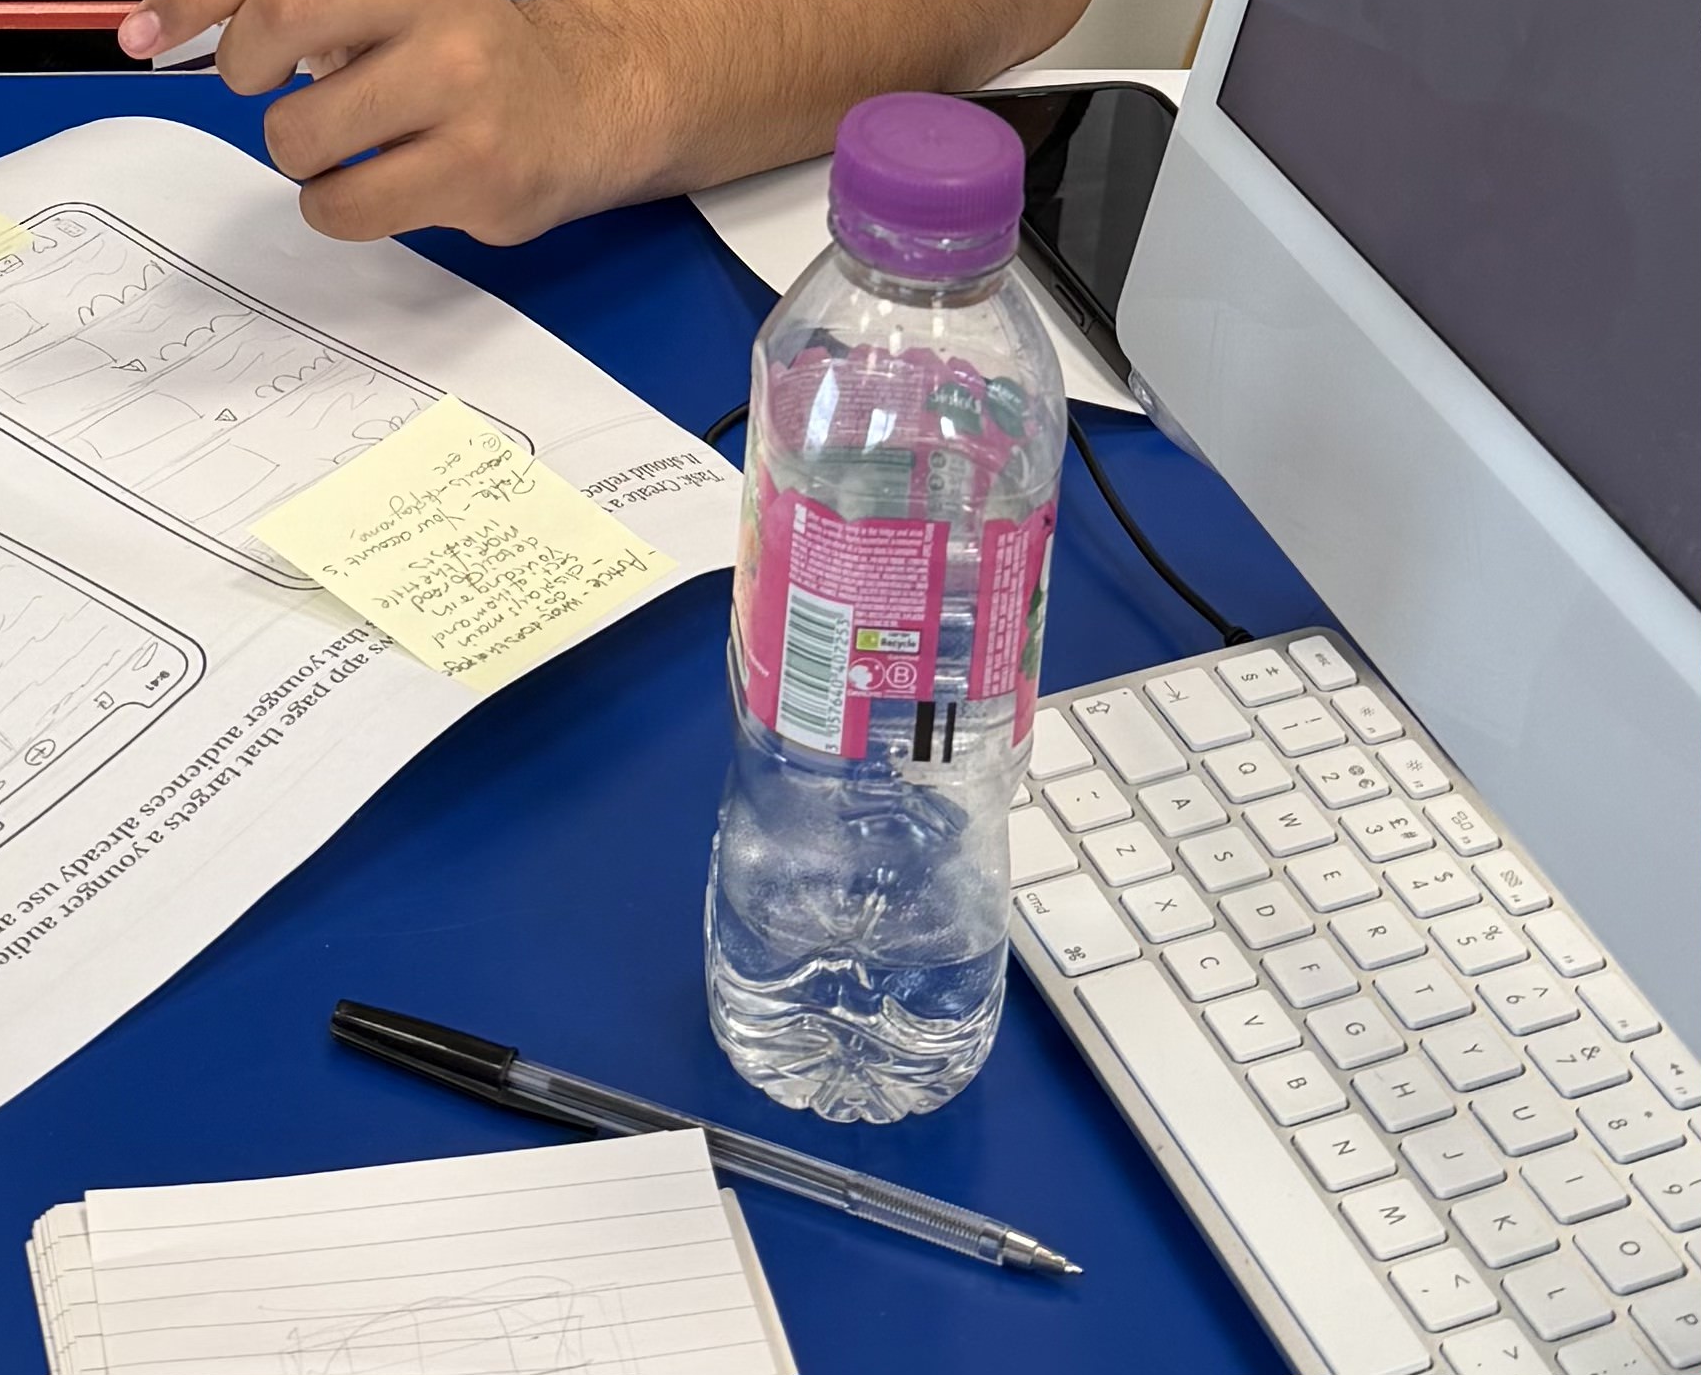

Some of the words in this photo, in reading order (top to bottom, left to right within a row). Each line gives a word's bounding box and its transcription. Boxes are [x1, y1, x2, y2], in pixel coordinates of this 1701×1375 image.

[580, 472, 632, 498] reflec
[628, 456, 685, 480] should
[609, 498, 624, 509] a
[622, 479, 681, 502] Create
[322, 625, 370, 660] that
[144, 670, 171, 692] 9:41
[330, 652, 370, 687] app
[243, 654, 327, 728] younger
[281, 685, 331, 727] page
[236, 726, 285, 767] that
[139, 725, 244, 817] audiences
[164, 765, 242, 831] targets
[59, 816, 140, 883] already
[147, 829, 165, 844] a
[59, 842, 150, 918] younger
[17, 882, 60, 914] use
[1026, 892, 1050, 914] cmd
